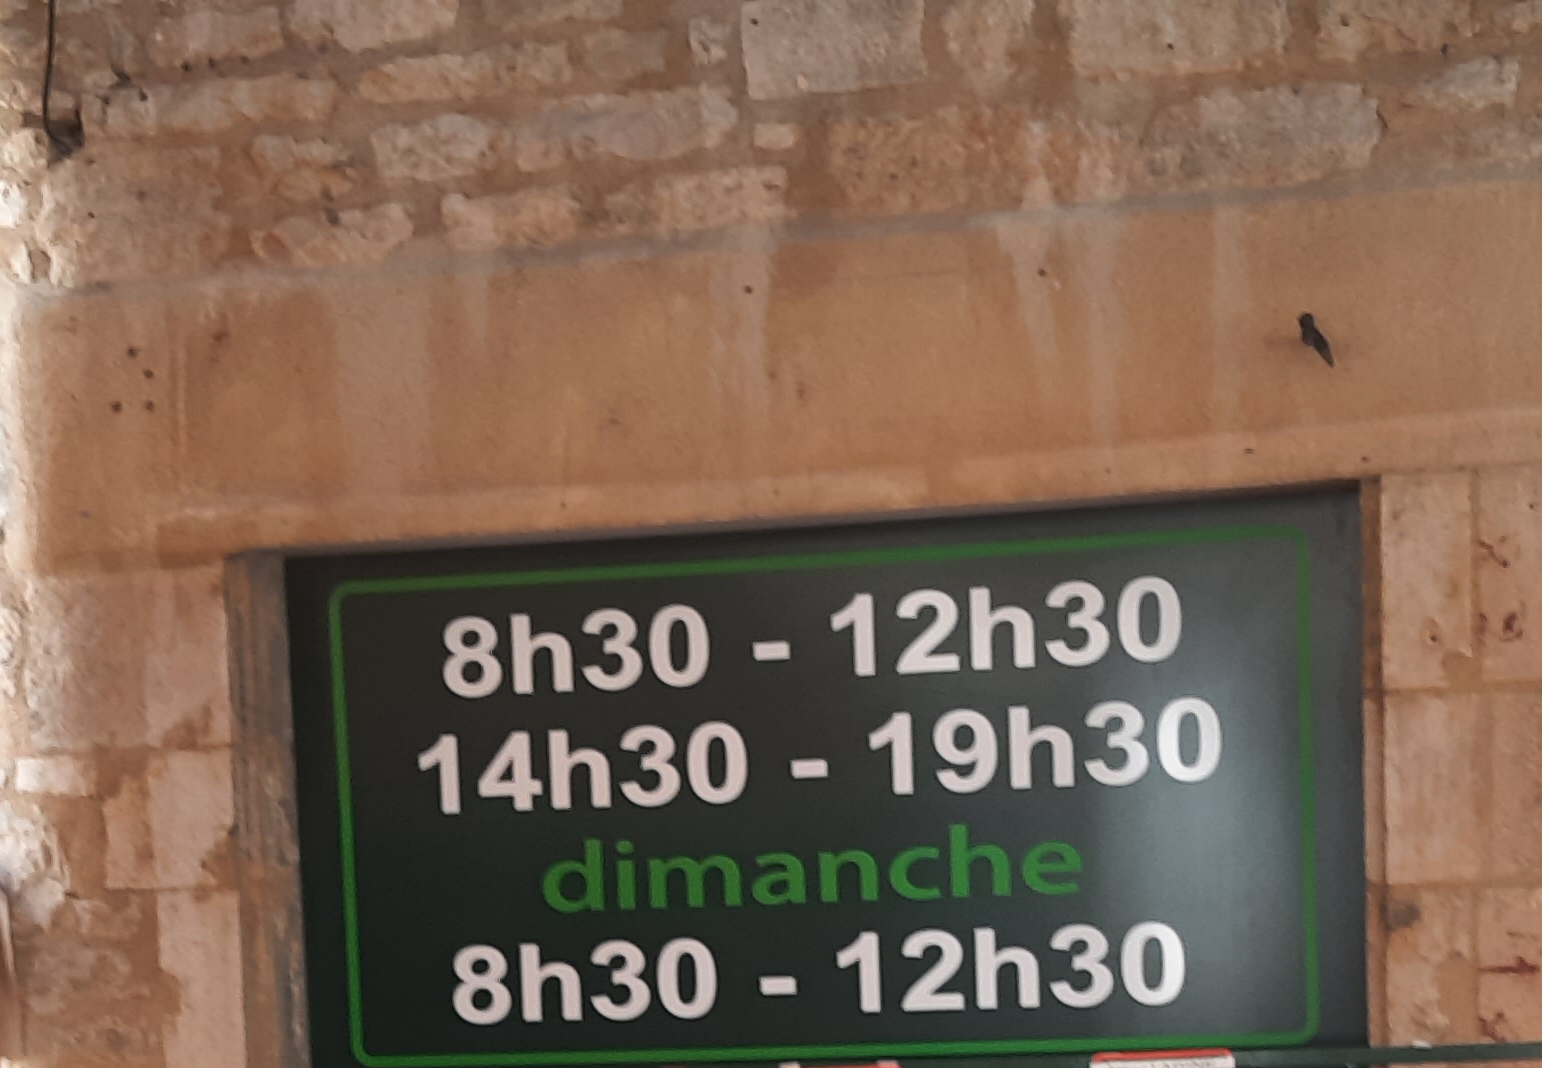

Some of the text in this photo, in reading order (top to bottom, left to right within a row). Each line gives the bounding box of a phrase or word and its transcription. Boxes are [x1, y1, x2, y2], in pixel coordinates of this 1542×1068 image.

[442, 576, 1183, 699] 8h30 - 12h30
[417, 697, 1222, 815] 14h30 - 19h30
[542, 824, 1083, 914] dimanche
[452, 921, 1186, 1025] 8h30 - 12h30
